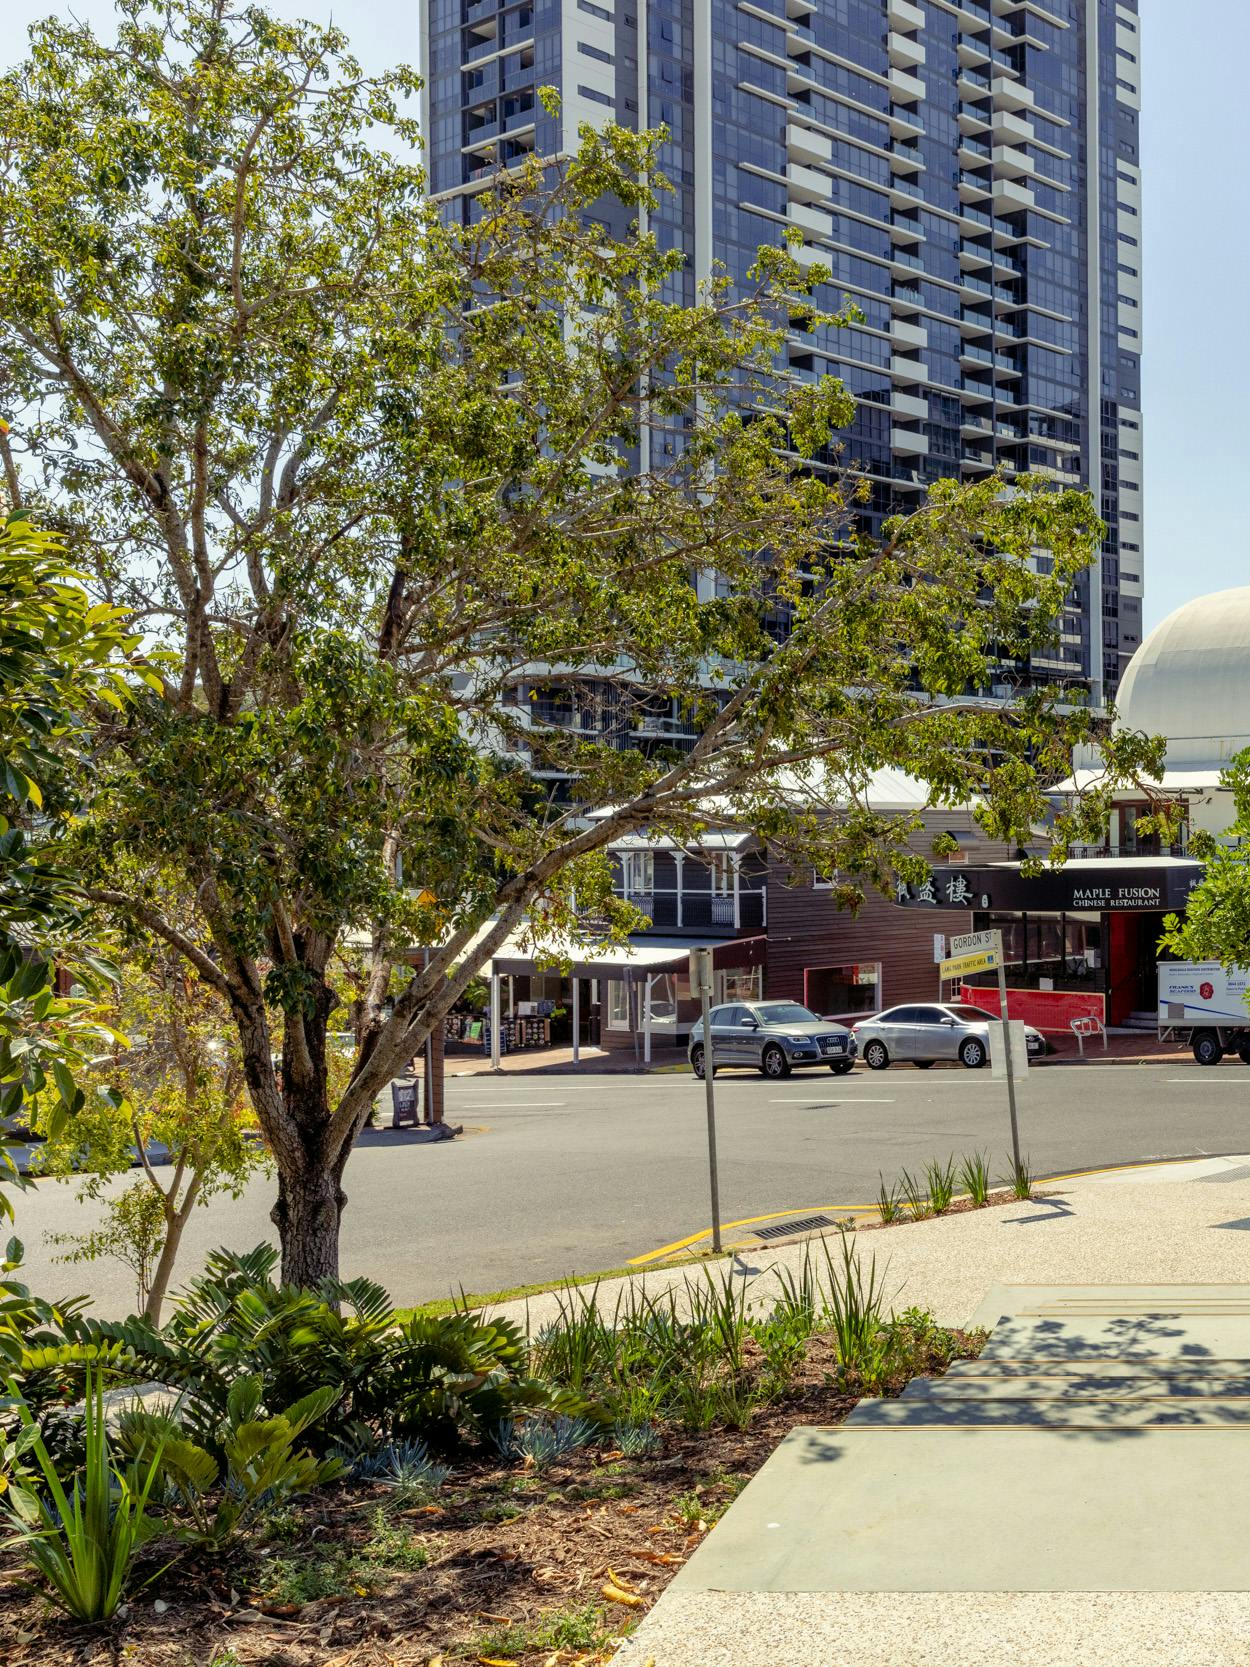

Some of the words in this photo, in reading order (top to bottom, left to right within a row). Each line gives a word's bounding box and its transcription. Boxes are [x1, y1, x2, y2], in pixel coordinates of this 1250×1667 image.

[1073, 888, 1111, 898] MAPLE
[1118, 887, 1160, 898] FUSION
[1073, 899, 1106, 907] CHINESE
[1110, 898, 1161, 907] RESTAURANT
[953, 933, 982, 949] GORDON
[985, 931, 992, 943] ST
[962, 960, 977, 969] TRAFFIC
[976, 958, 986, 966] AREA
